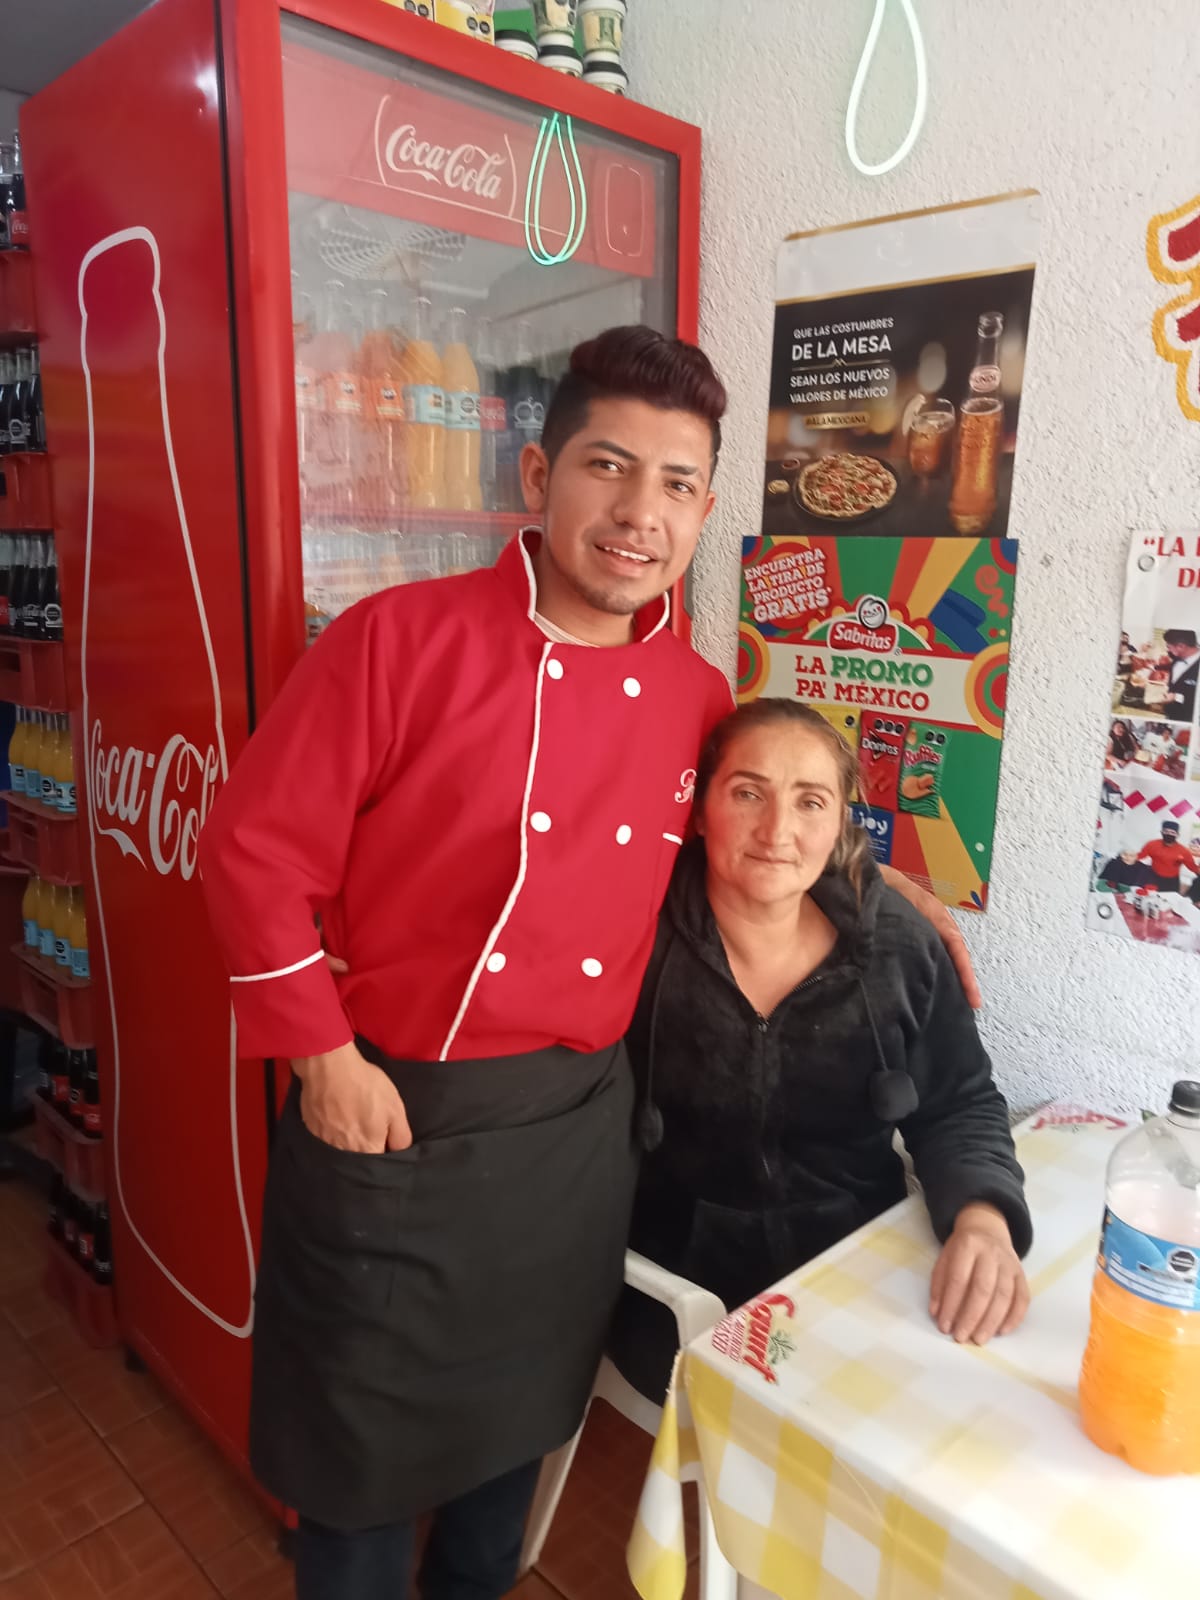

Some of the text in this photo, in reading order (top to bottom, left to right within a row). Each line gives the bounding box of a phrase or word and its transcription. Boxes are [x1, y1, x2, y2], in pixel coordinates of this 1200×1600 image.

[385, 124, 506, 199] Coca-Cola
[793, 317, 894, 339] QUE LAS COSTUMBRES
[791, 334, 892, 361] DE LA MESA
[790, 368, 890, 388] SEAN LOS NUEVOS
[789, 385, 889, 404] VALORES DE MÉXICO
[743, 548, 826, 581] ENCUENTRA
[748, 562, 825, 593] LA TIRA DE
[753, 576, 824, 605] PRODUCTO
[833, 622, 893, 650] Sabritas
[795, 655, 934, 688] LA PROMO
[795, 678, 930, 712] PA' MÉXICO
[862, 737, 899, 756] Doritos
[91, 719, 219, 881] Coca-Col
